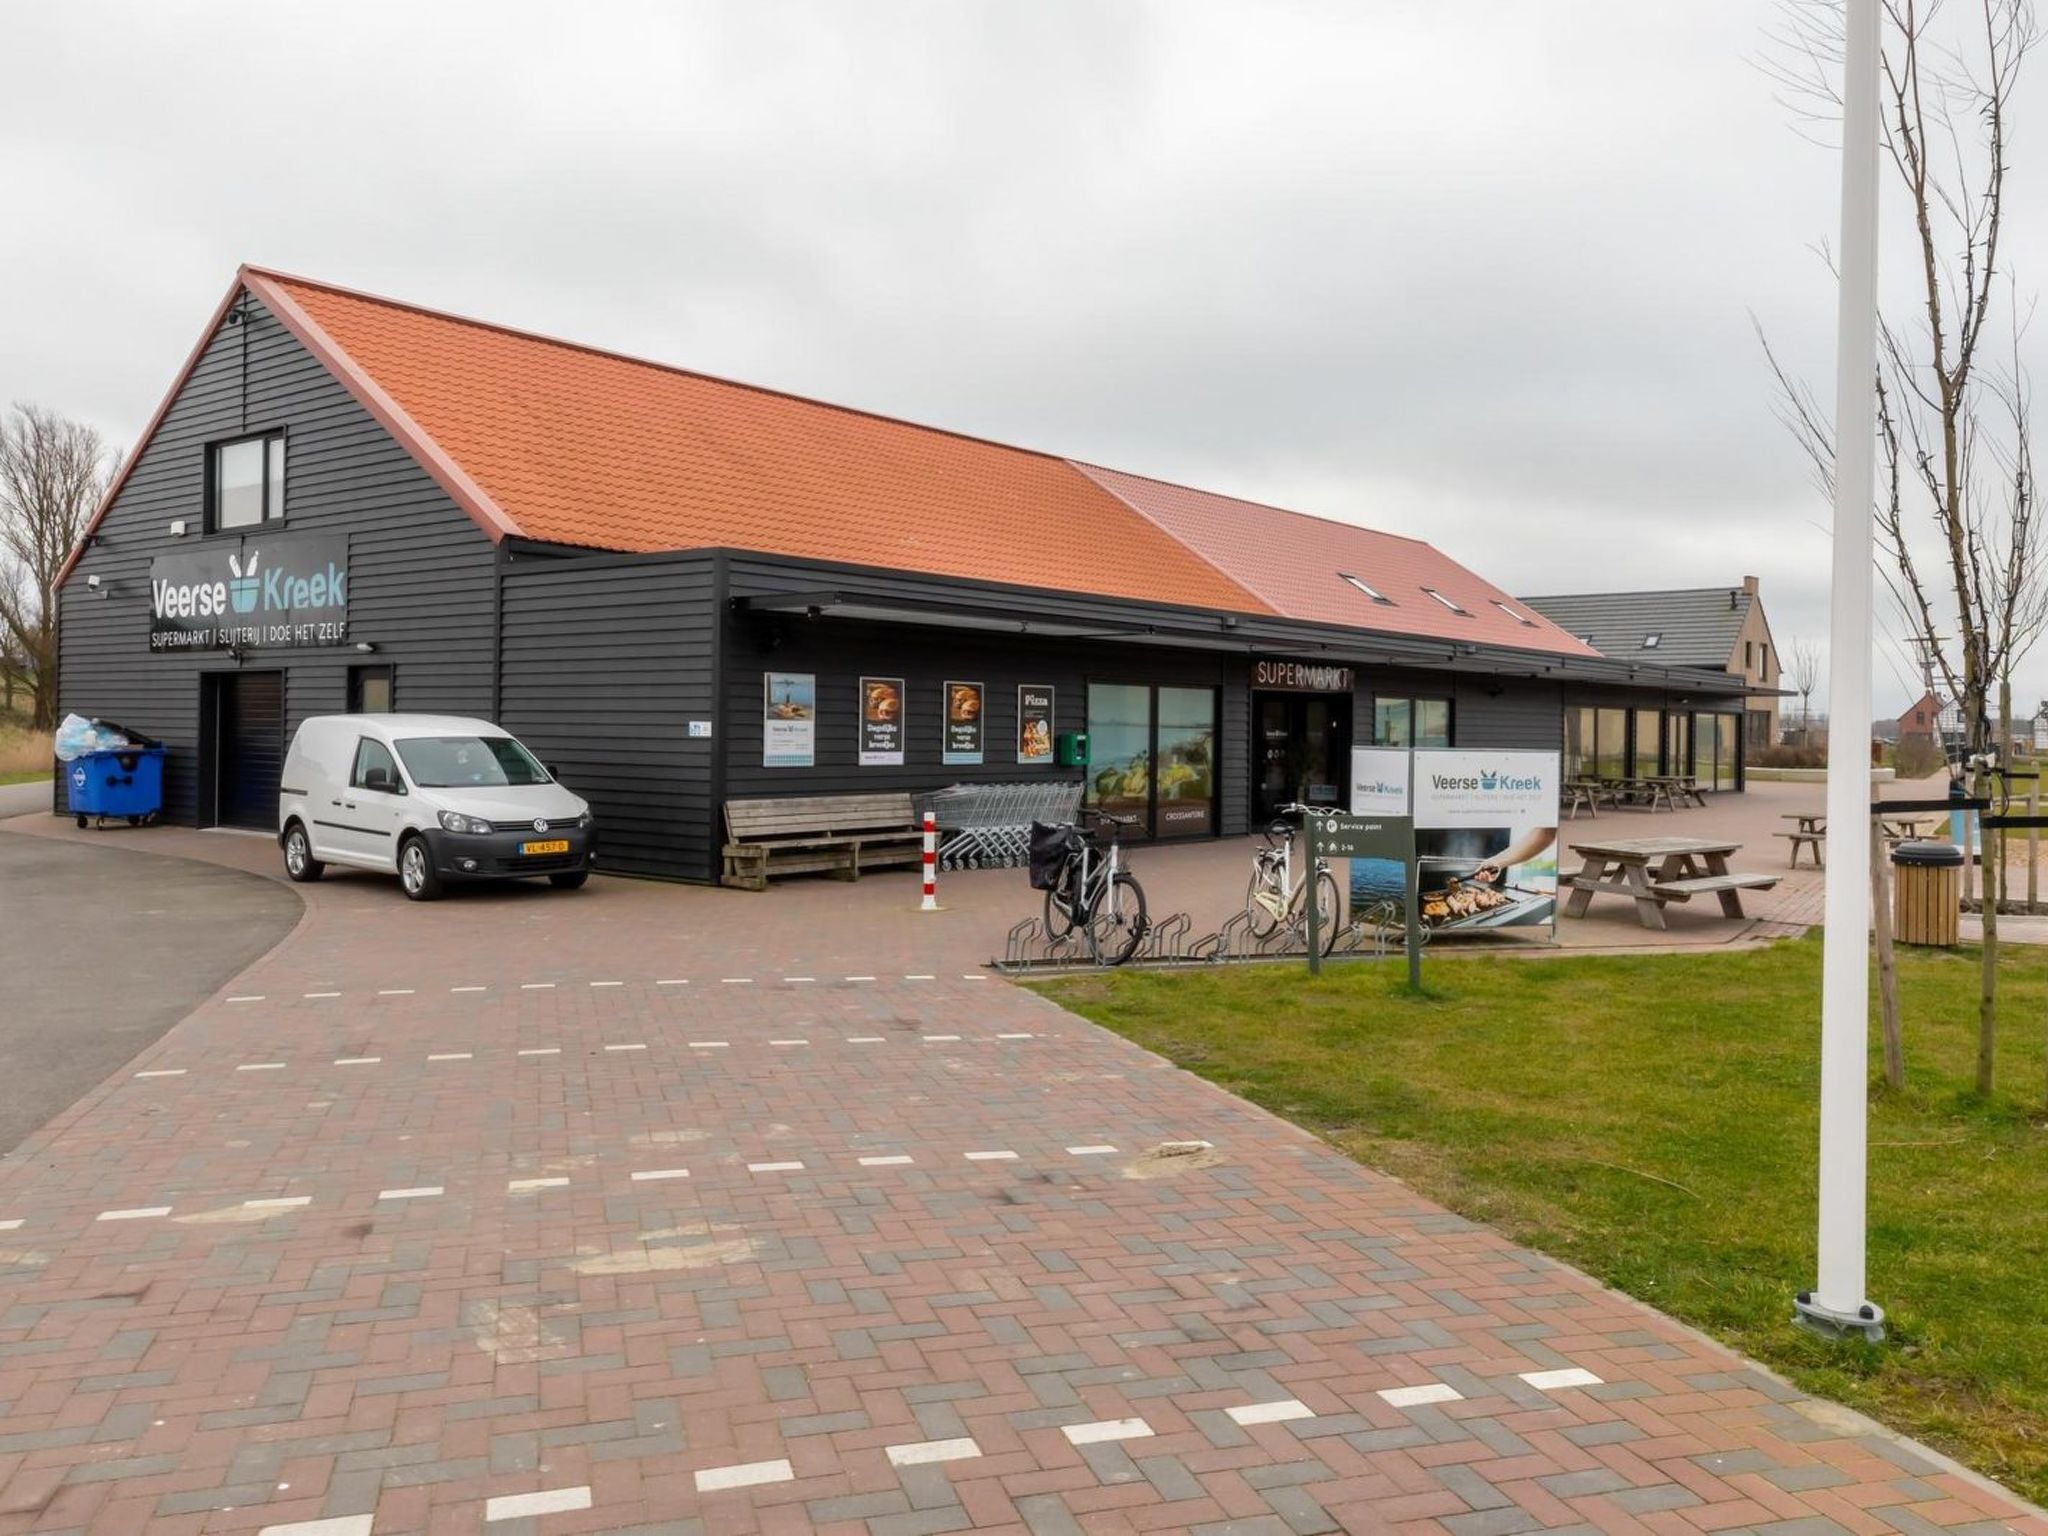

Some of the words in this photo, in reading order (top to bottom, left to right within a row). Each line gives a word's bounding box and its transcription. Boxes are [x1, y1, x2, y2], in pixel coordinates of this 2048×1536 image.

[152, 578, 227, 618] Veerse
[263, 561, 345, 611] Kreek
[151, 629, 210, 648] SUPERMARKT
[269, 625, 291, 642] DOE
[295, 623, 315, 641] HET
[319, 621, 346, 640] ZELF
[1257, 660, 1349, 690] SUPERMARKT
[1025, 694, 1049, 706] Pizza
[1432, 774, 1479, 790] Veerse
[1499, 775, 1541, 791] Kreek
[1340, 822, 1363, 830] Service
[1365, 823, 1382, 831] point
